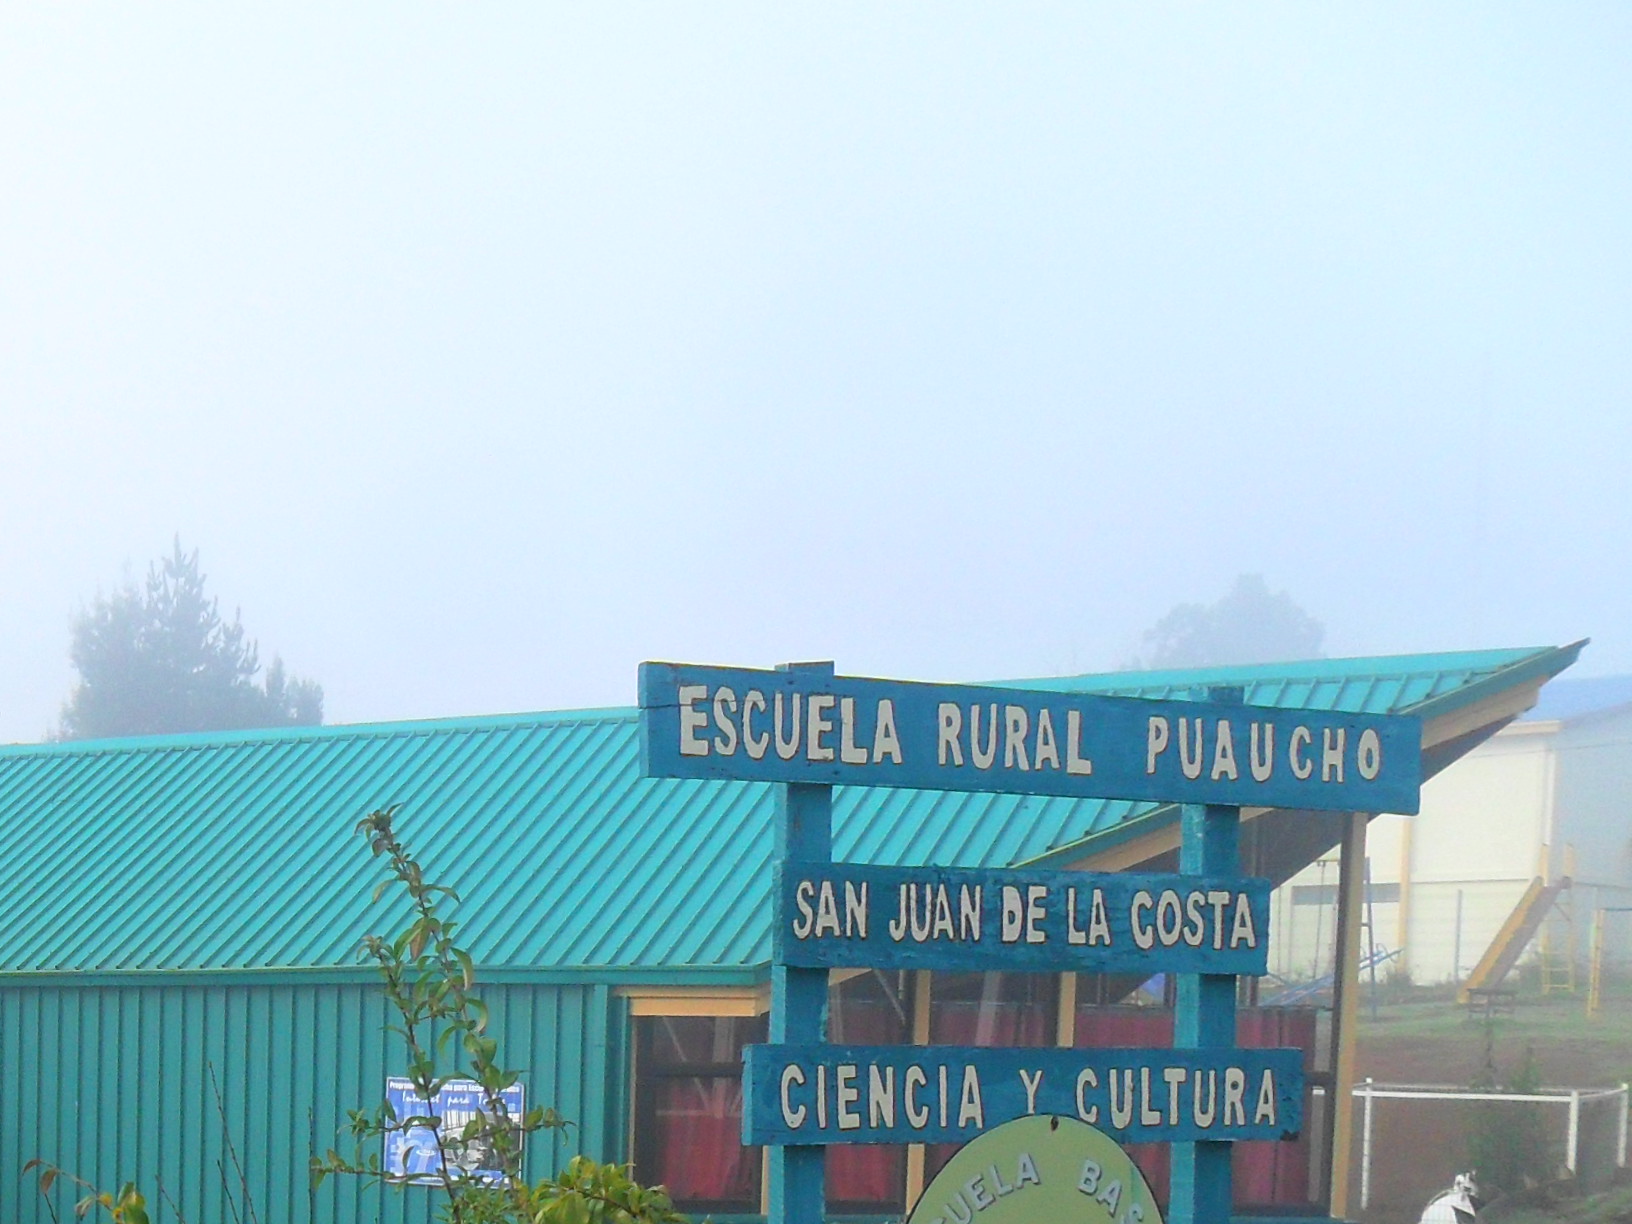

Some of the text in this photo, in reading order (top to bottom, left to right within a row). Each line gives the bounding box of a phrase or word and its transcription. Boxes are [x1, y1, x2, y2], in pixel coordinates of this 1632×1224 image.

[677, 684, 1382, 783] ESCUELA RURAL PUAUCHO
[791, 879, 1257, 952] SAN JUAN DE LA COSTA
[779, 1063, 1277, 1129] CIENCIA Y CULTURA
